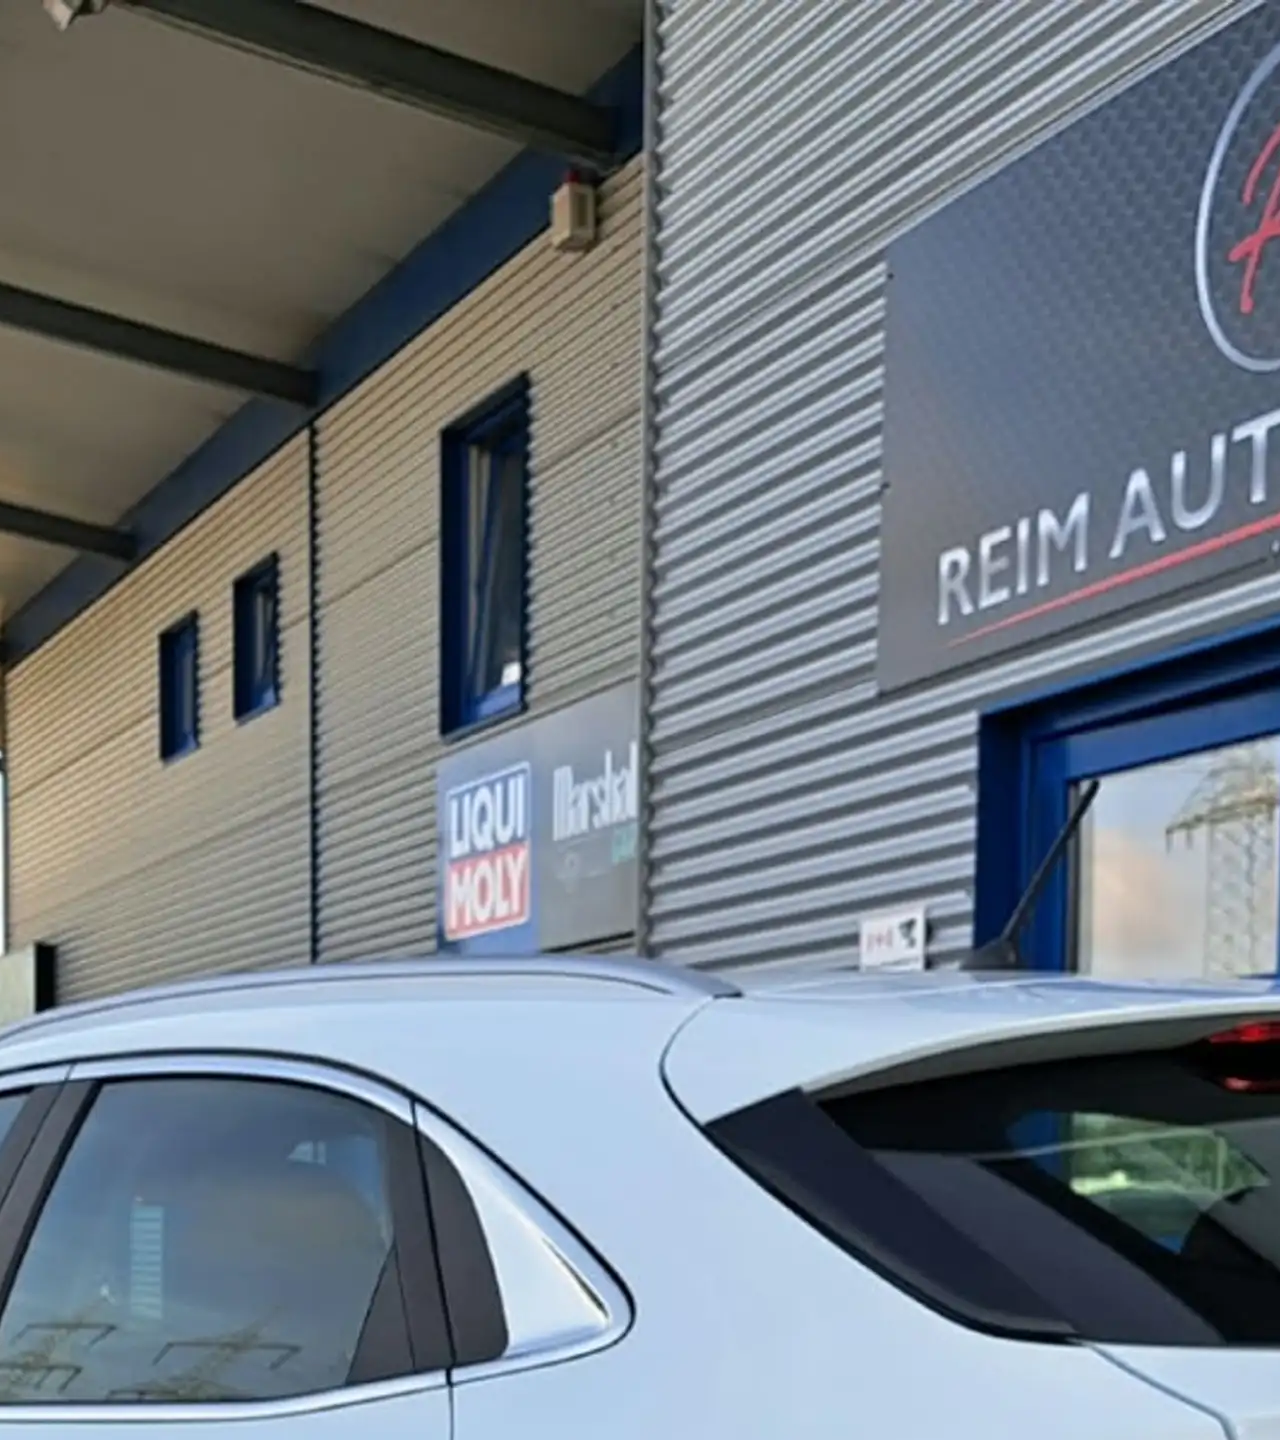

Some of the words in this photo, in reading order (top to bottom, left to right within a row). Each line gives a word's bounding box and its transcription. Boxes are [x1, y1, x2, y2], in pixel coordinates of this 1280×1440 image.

[937, 490, 1091, 626] REIM
[450, 773, 526, 859] LIQUI
[449, 848, 528, 930] MOLY
